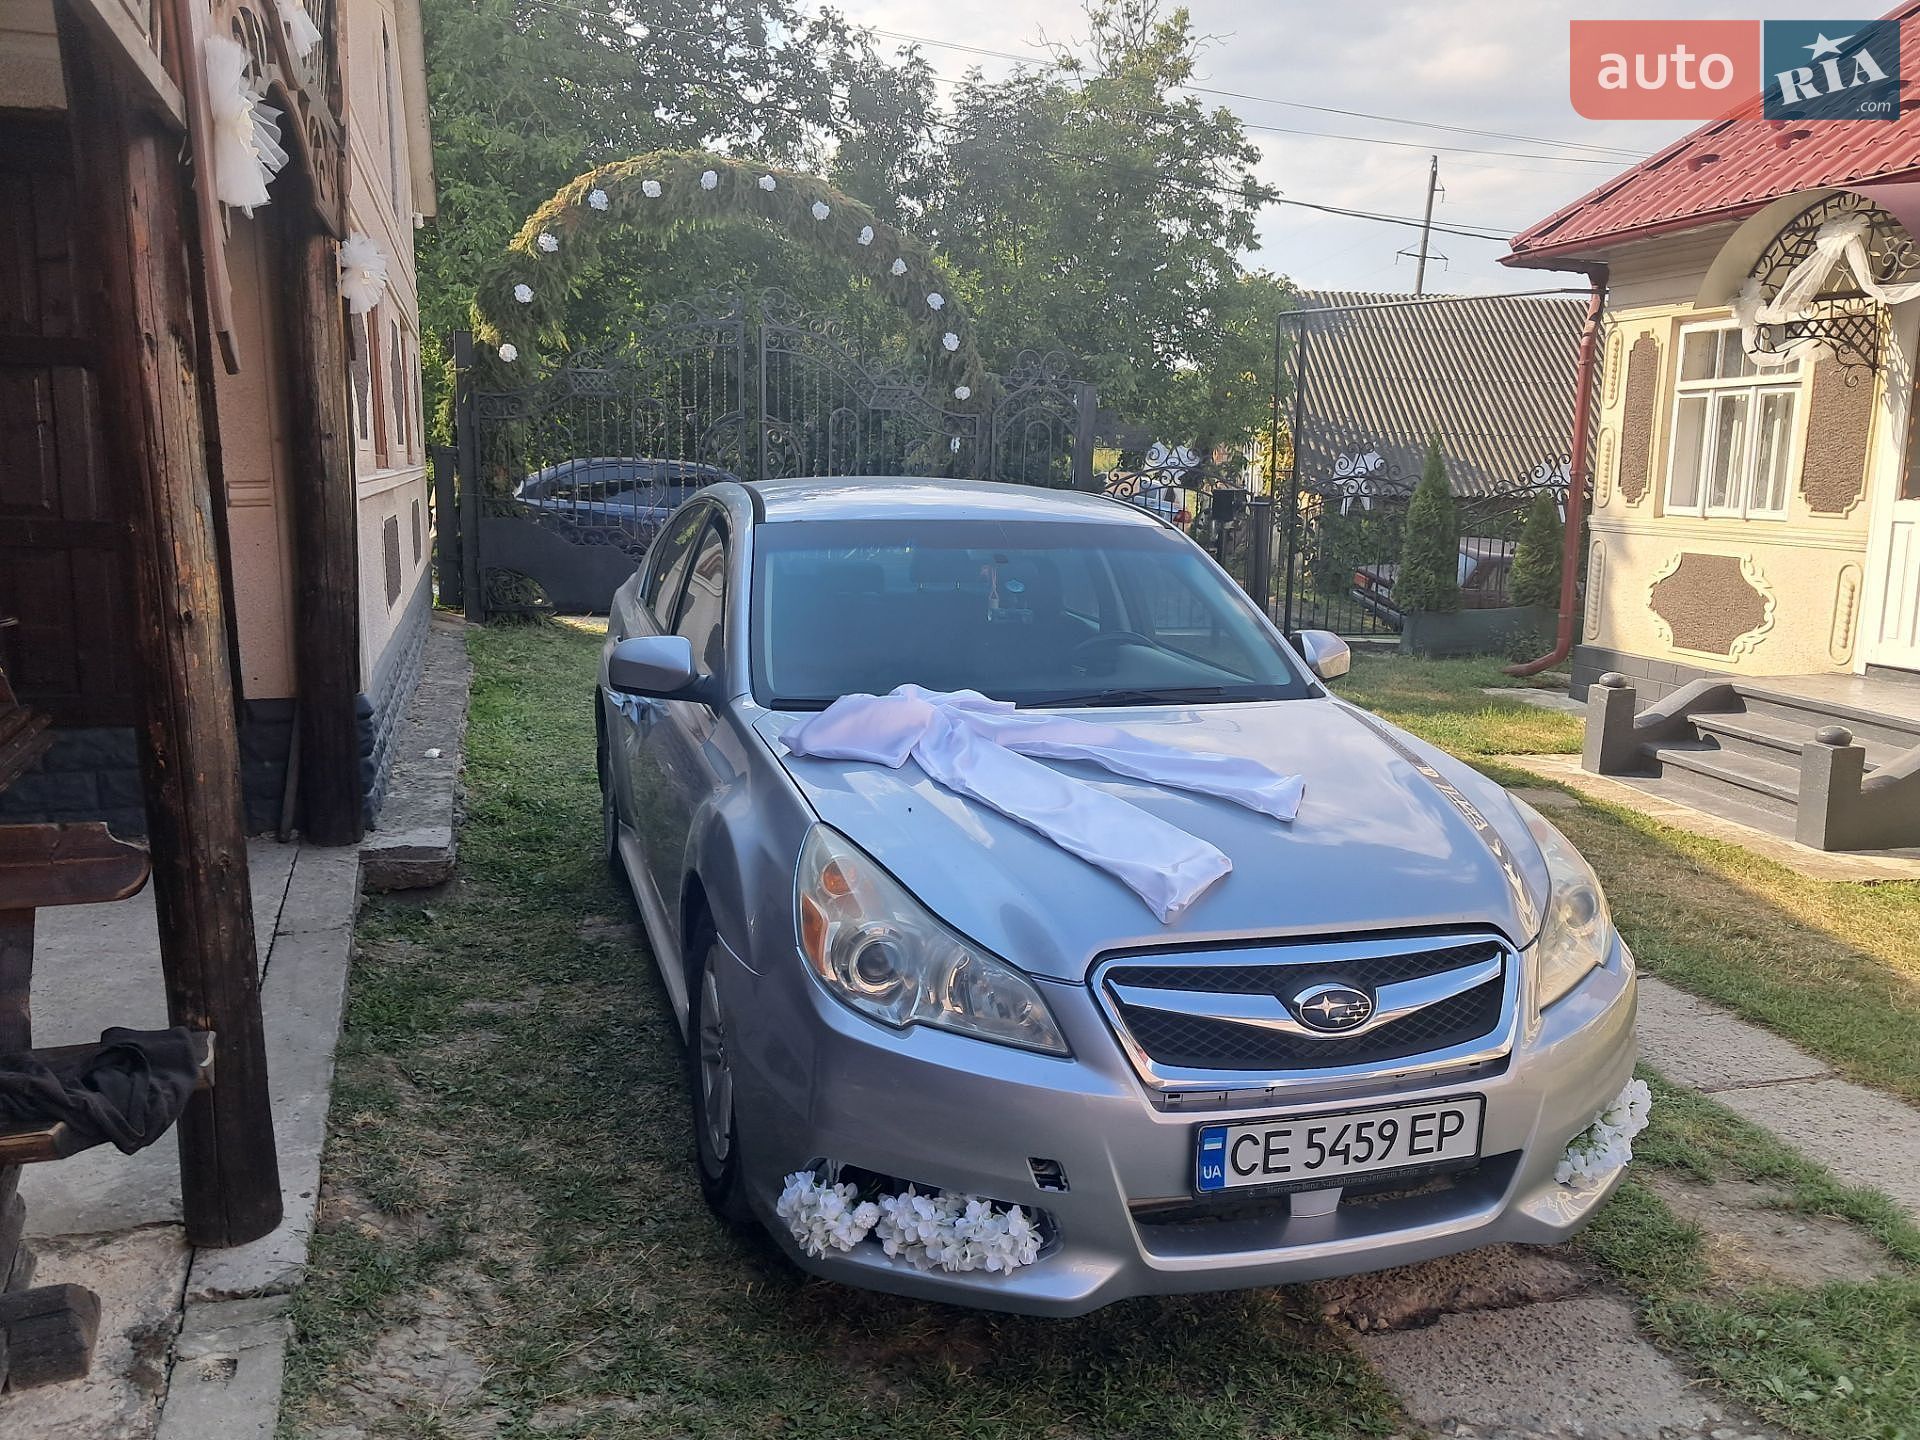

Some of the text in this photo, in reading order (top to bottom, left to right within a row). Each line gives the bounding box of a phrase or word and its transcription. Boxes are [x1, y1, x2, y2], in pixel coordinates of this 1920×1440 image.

[1230, 1109, 1465, 1176] CE 5459 EP
[1203, 1166, 1221, 1179] UA
